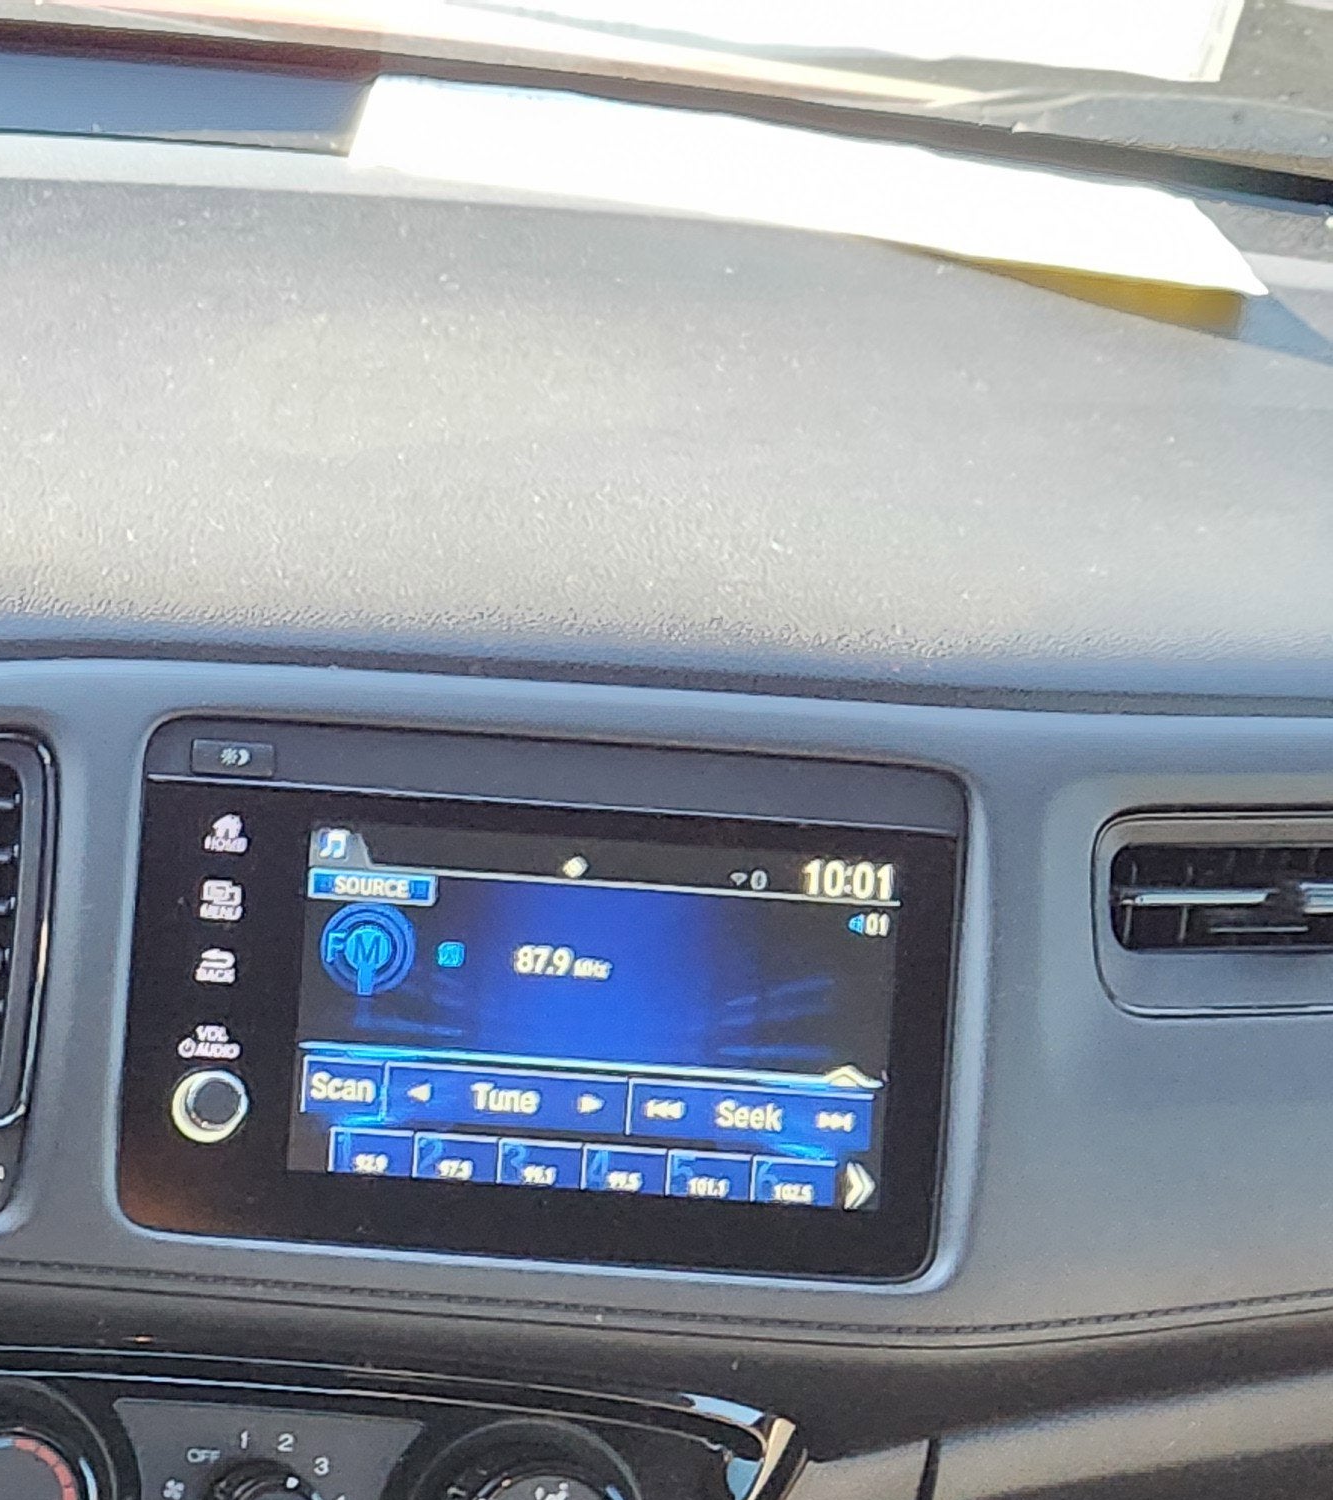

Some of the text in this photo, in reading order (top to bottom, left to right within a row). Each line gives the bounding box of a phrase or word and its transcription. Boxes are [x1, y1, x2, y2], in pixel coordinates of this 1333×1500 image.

[334, 876, 410, 899] SOURCE
[803, 858, 896, 901] 10:01
[864, 912, 891, 938] 01
[513, 944, 575, 977] 87.9
[195, 1024, 230, 1042] VOL
[194, 1042, 242, 1060] AUDIO
[309, 1070, 377, 1104] Scan
[469, 1081, 542, 1115] Tune
[714, 1098, 783, 1132] Seek
[240, 1429, 250, 1450] 1
[276, 1432, 296, 1453] 2
[186, 1447, 222, 1463] OFF
[313, 1456, 330, 1477] 3
